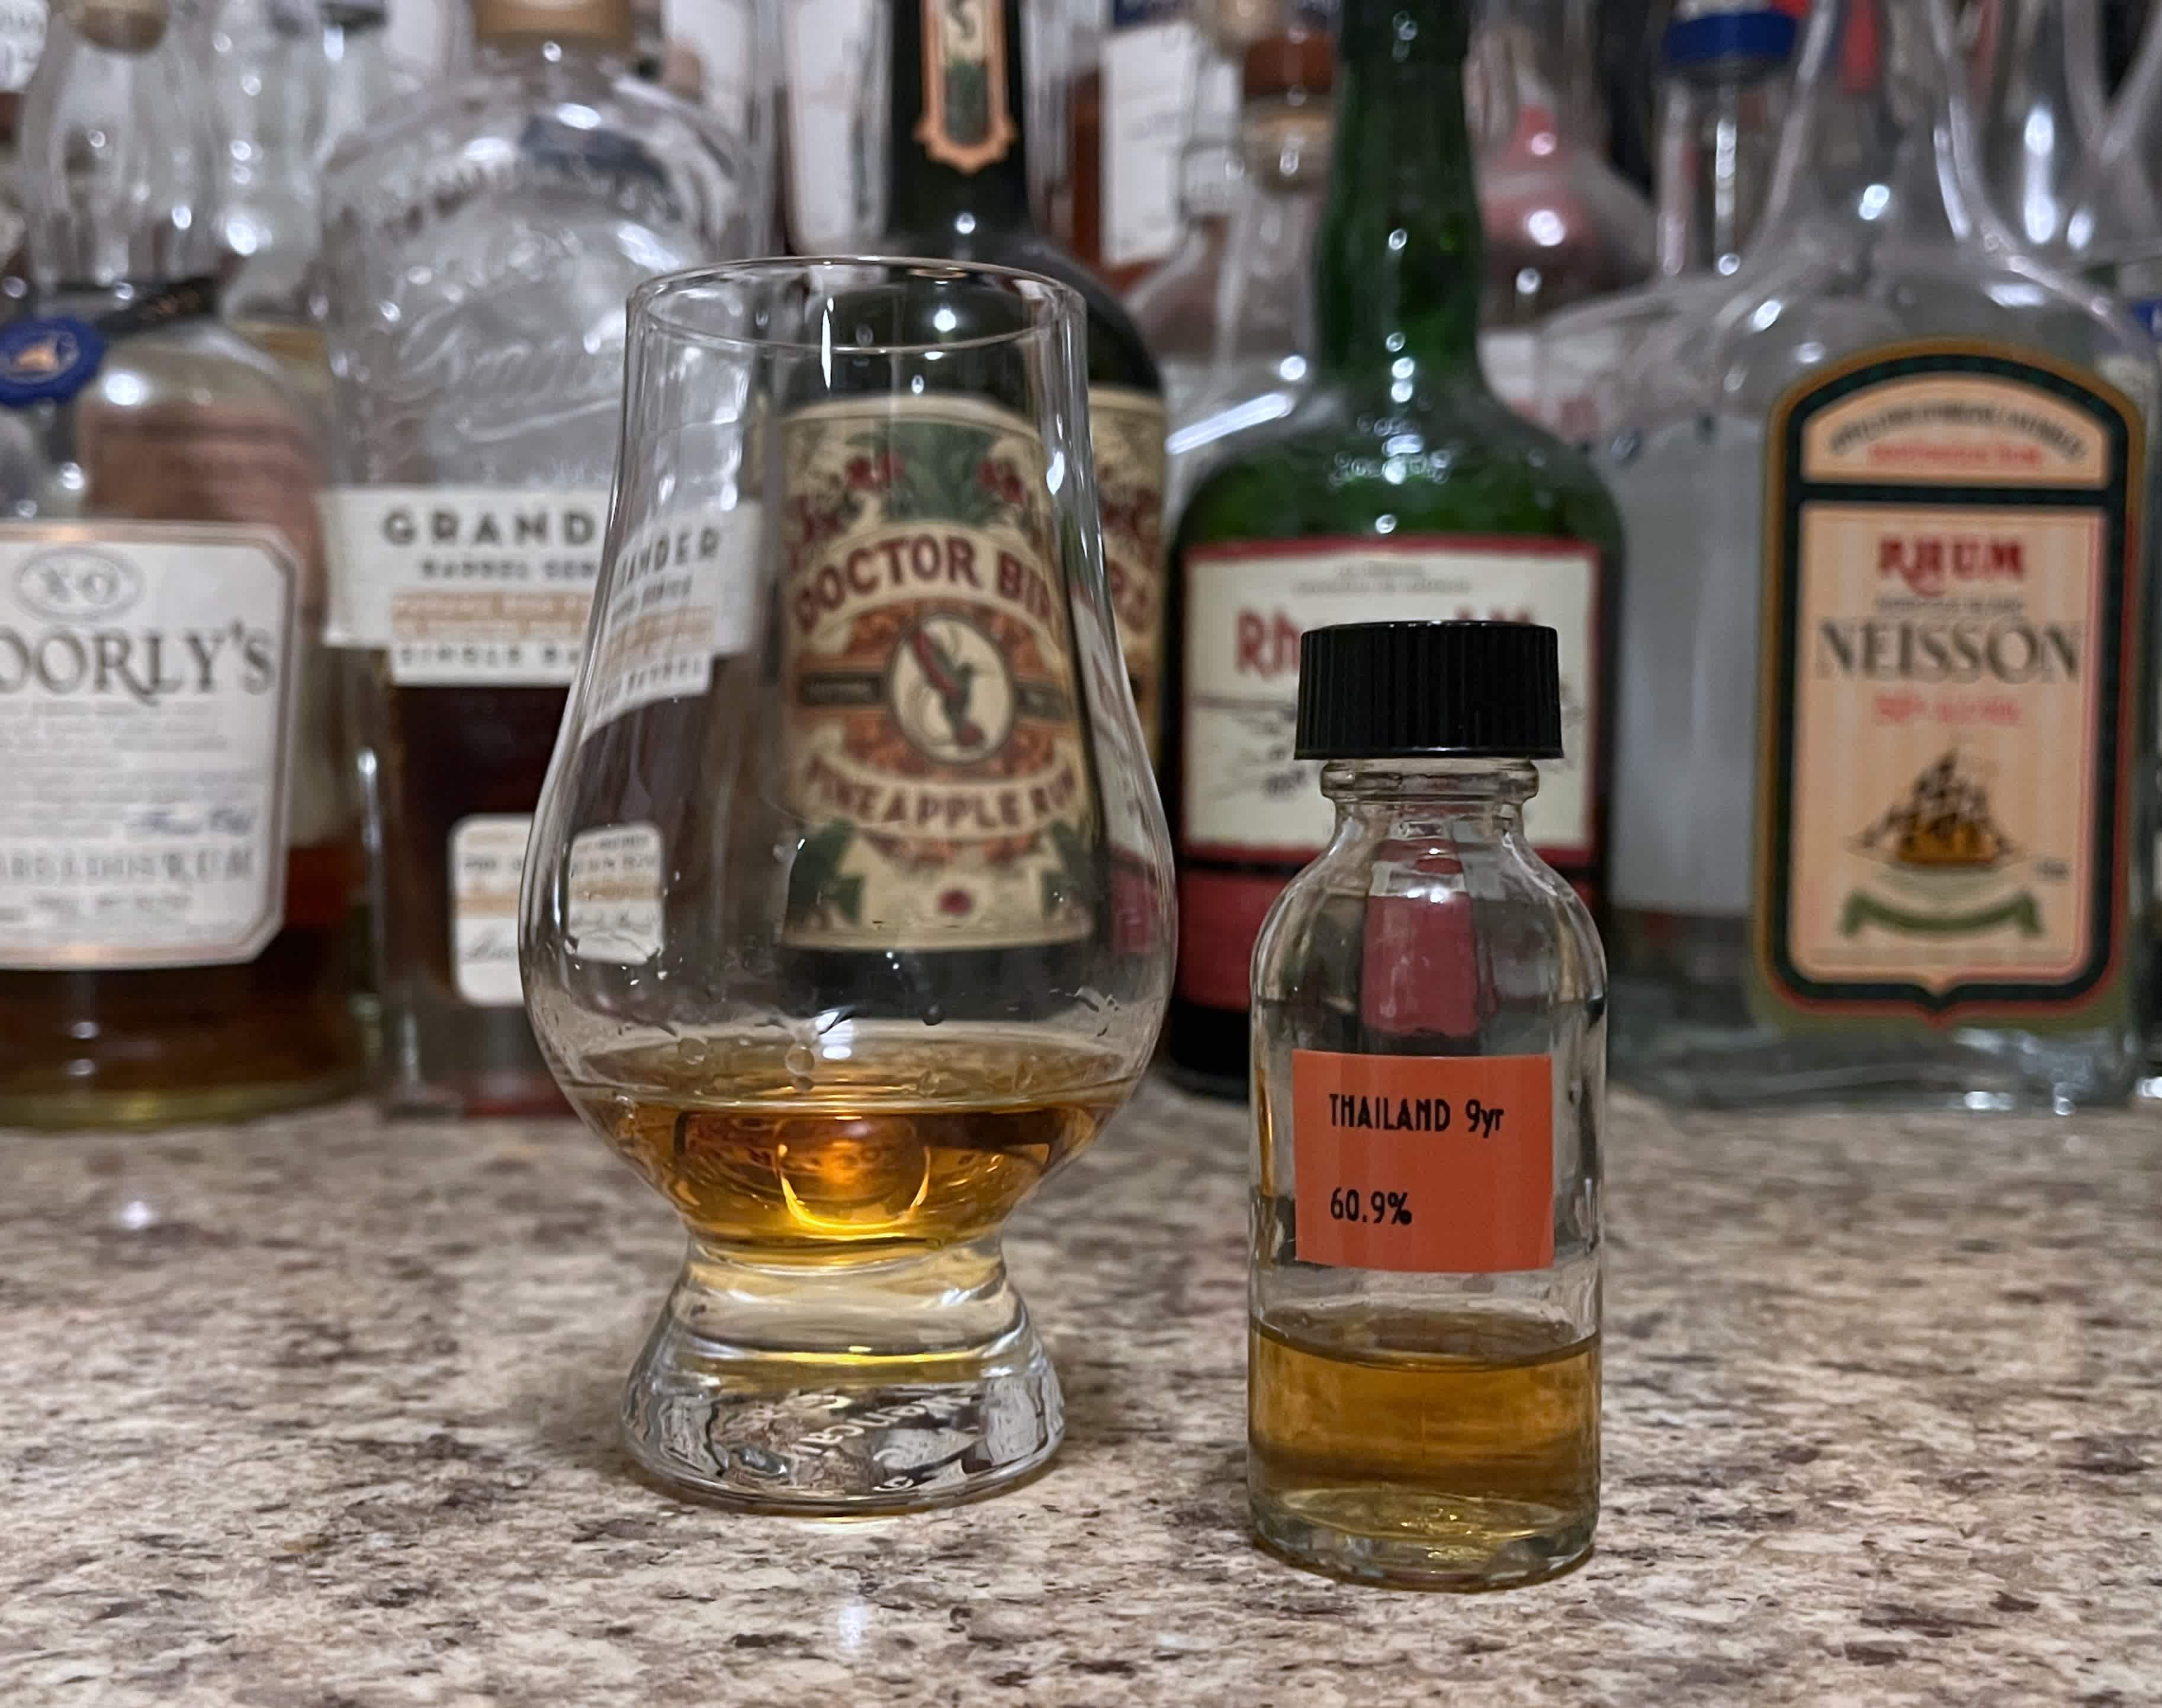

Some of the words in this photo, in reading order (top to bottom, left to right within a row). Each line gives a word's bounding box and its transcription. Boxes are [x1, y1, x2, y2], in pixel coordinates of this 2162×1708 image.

[382, 510, 596, 546] GRAND
[795, 533, 982, 635] DOCTOR
[1877, 535, 2026, 599] RHUM
[0, 617, 278, 707] OORLY'S
[1817, 612, 2083, 684] NEISSON
[1329, 1093, 1450, 1132] THAILAND
[1465, 1098, 1505, 1138] 9yr
[1331, 1187, 1412, 1225] 60.9%
